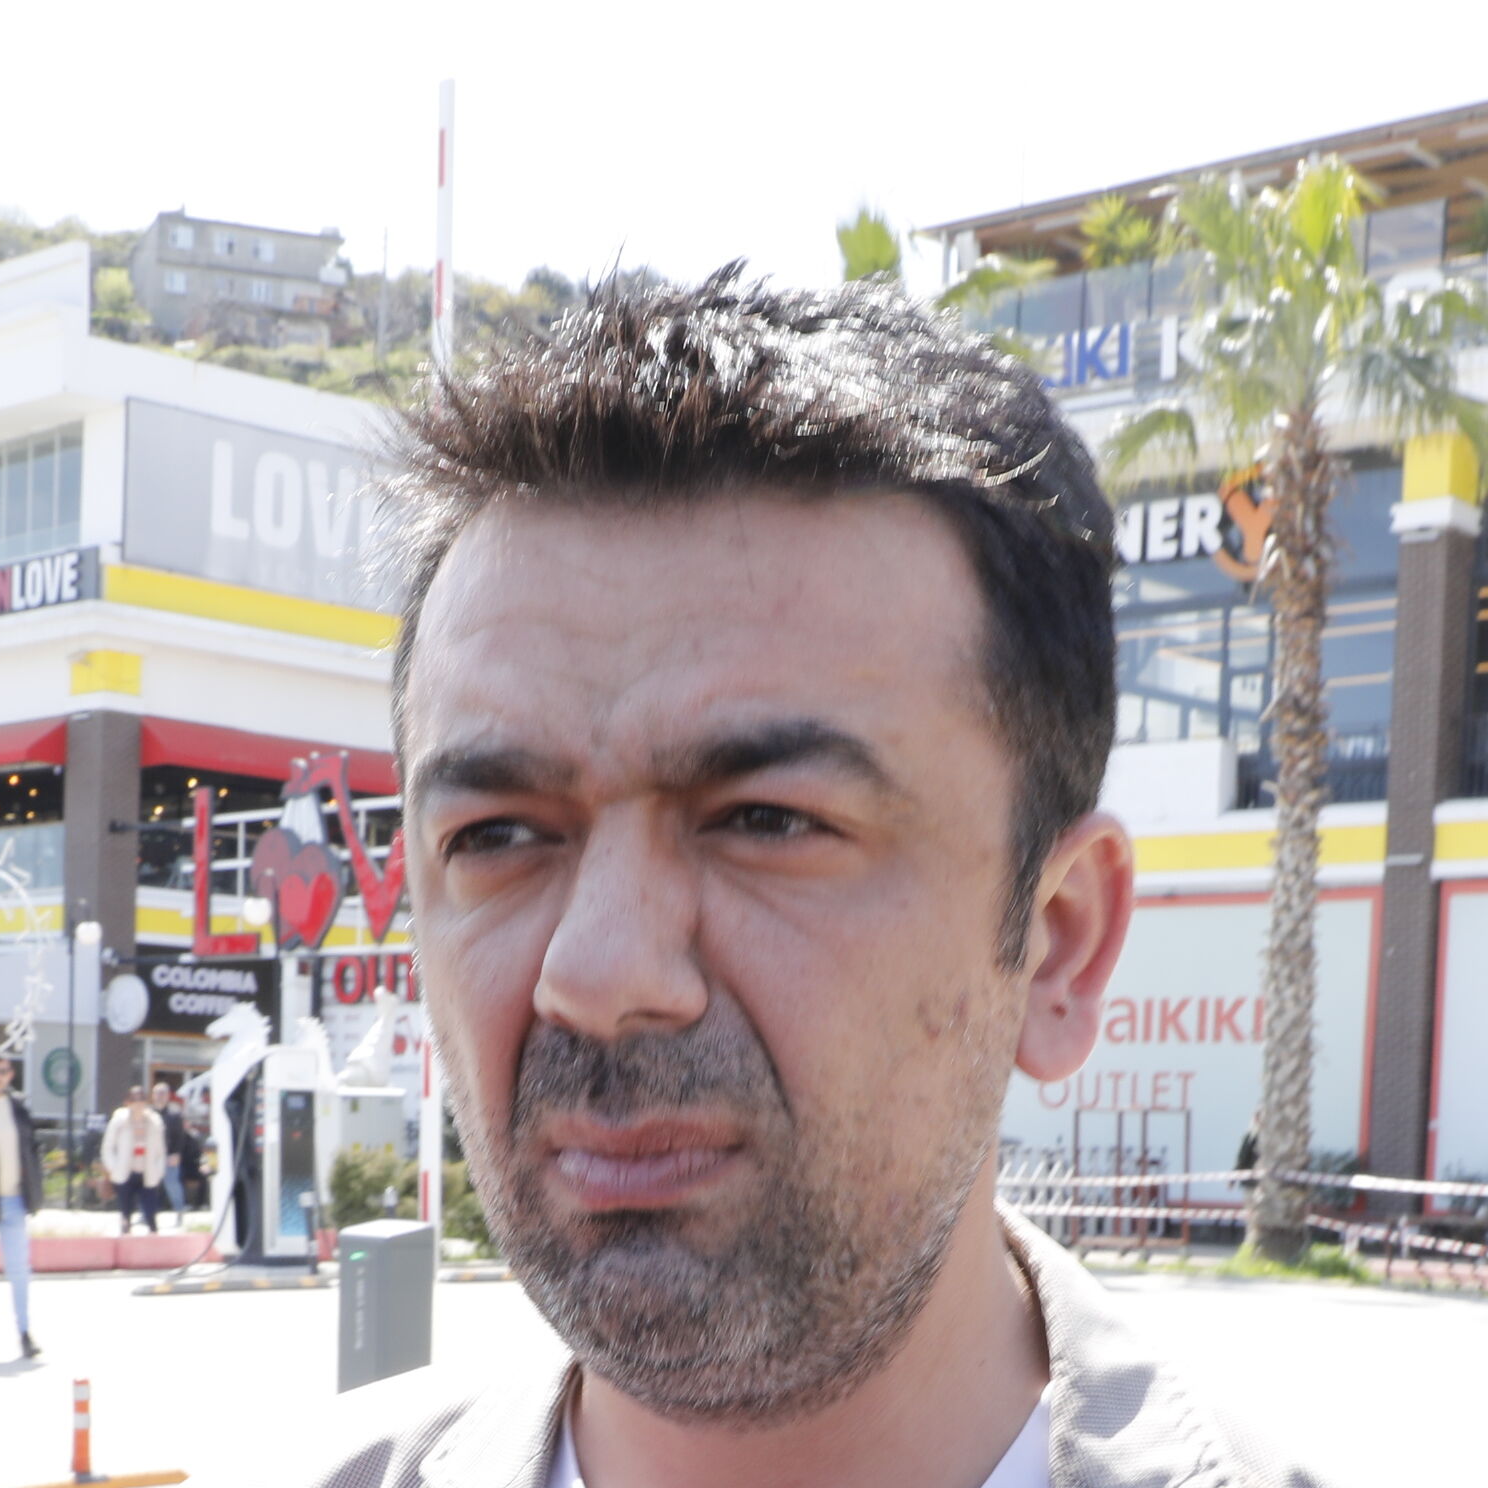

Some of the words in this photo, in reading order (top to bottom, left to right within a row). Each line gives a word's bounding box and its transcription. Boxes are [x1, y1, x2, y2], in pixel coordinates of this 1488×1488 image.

[1115, 493, 1222, 564] NER
[12, 551, 80, 611] LOVE
[151, 964, 258, 994] COLOMBIA
[333, 953, 420, 1005] OUT
[1037, 1070, 1197, 1112] OUTLET
